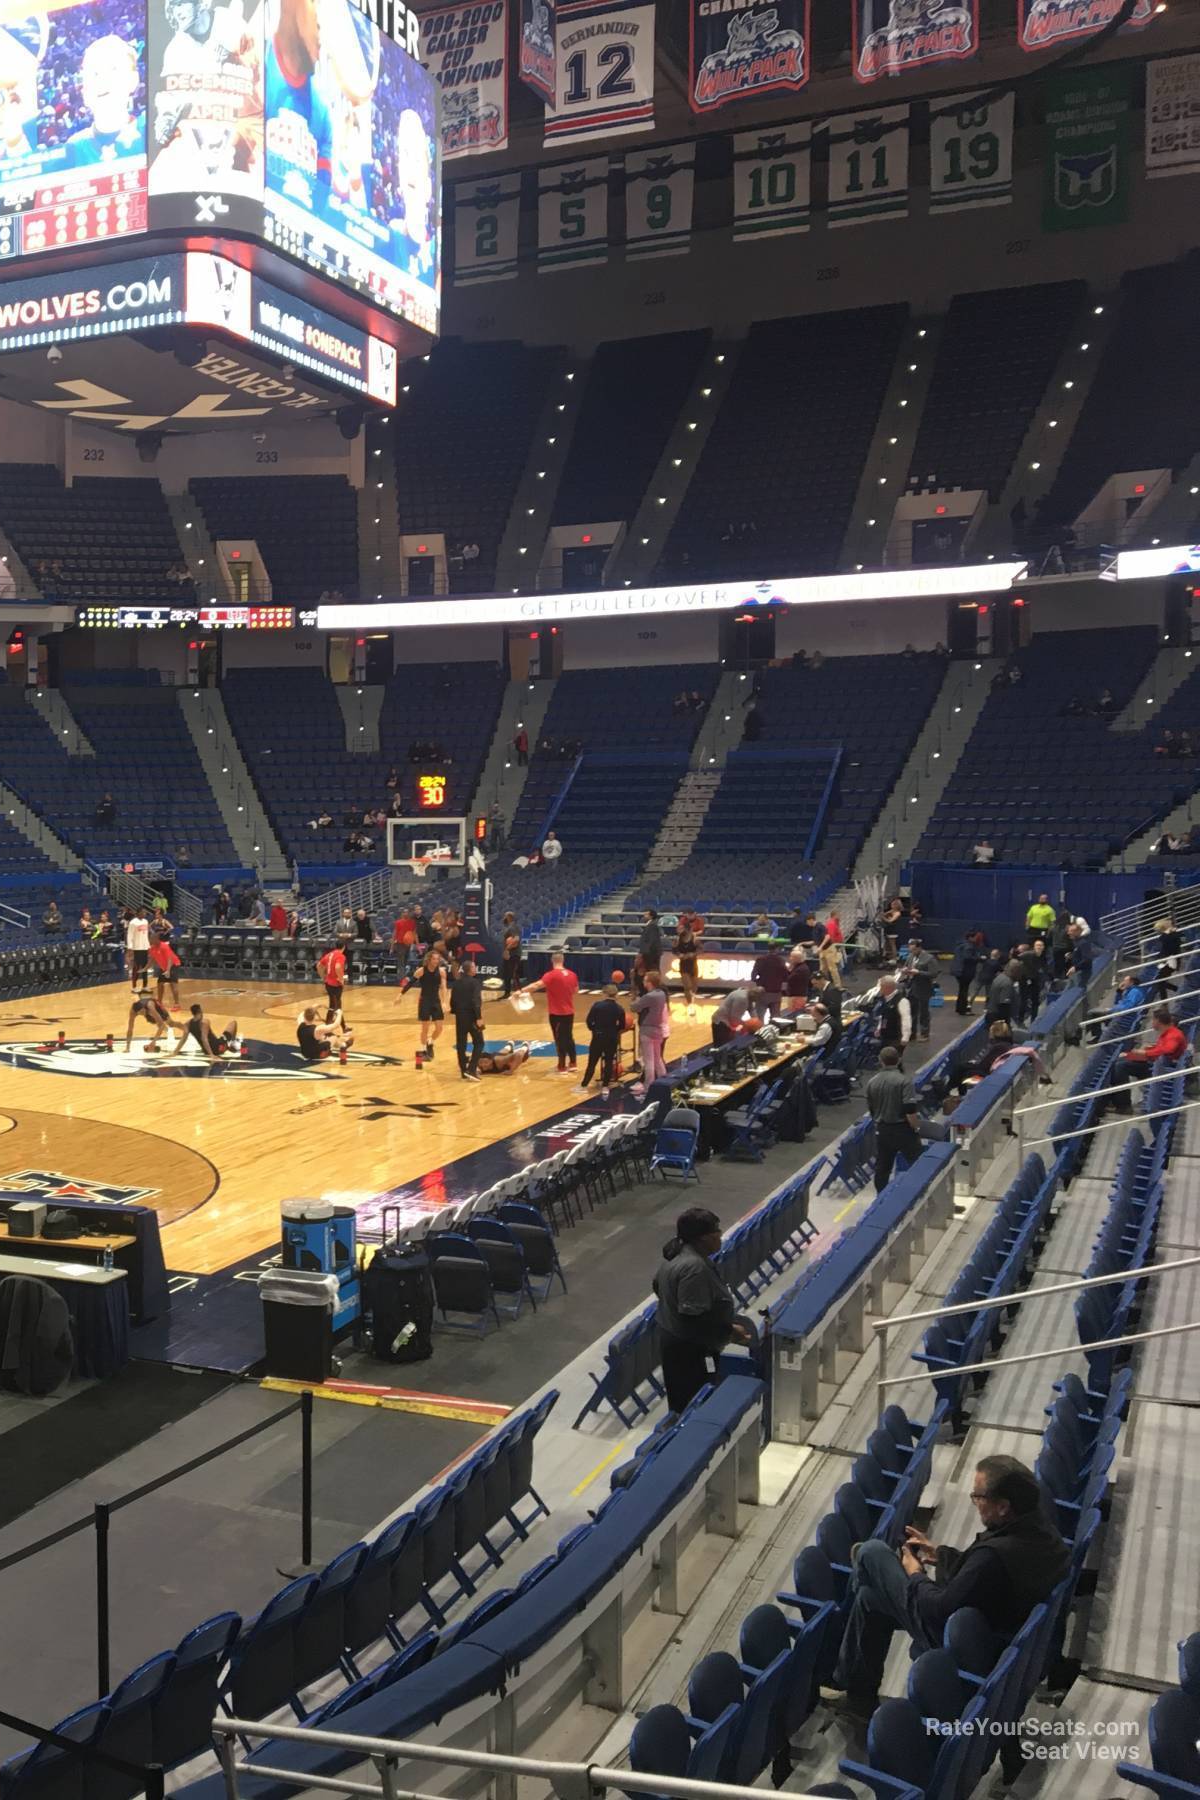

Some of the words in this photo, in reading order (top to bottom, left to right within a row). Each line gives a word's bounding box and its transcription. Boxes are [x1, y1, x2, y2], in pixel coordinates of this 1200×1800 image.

[426, 25, 489, 55] CALDER
[560, 21, 640, 50] GERNANDER
[441, 47, 474, 70] CUP
[564, 41, 635, 105] 12
[846, 146, 890, 193] 11
[943, 132, 1000, 184] 19
[747, 162, 797, 208] 10
[195, 194, 230, 222] XL
[559, 198, 586, 240] 5
[646, 184, 672, 230] 9
[475, 215, 498, 257] 2
[259, 301, 281, 333] WE
[191, 352, 296, 399] CENTER
[83, 449, 105, 462] 232
[255, 451, 279, 463] 233
[520, 599, 560, 617] GET
[569, 594, 656, 614] PULLED
[664, 588, 727, 607] OVER
[423, 786, 444, 805] 30
